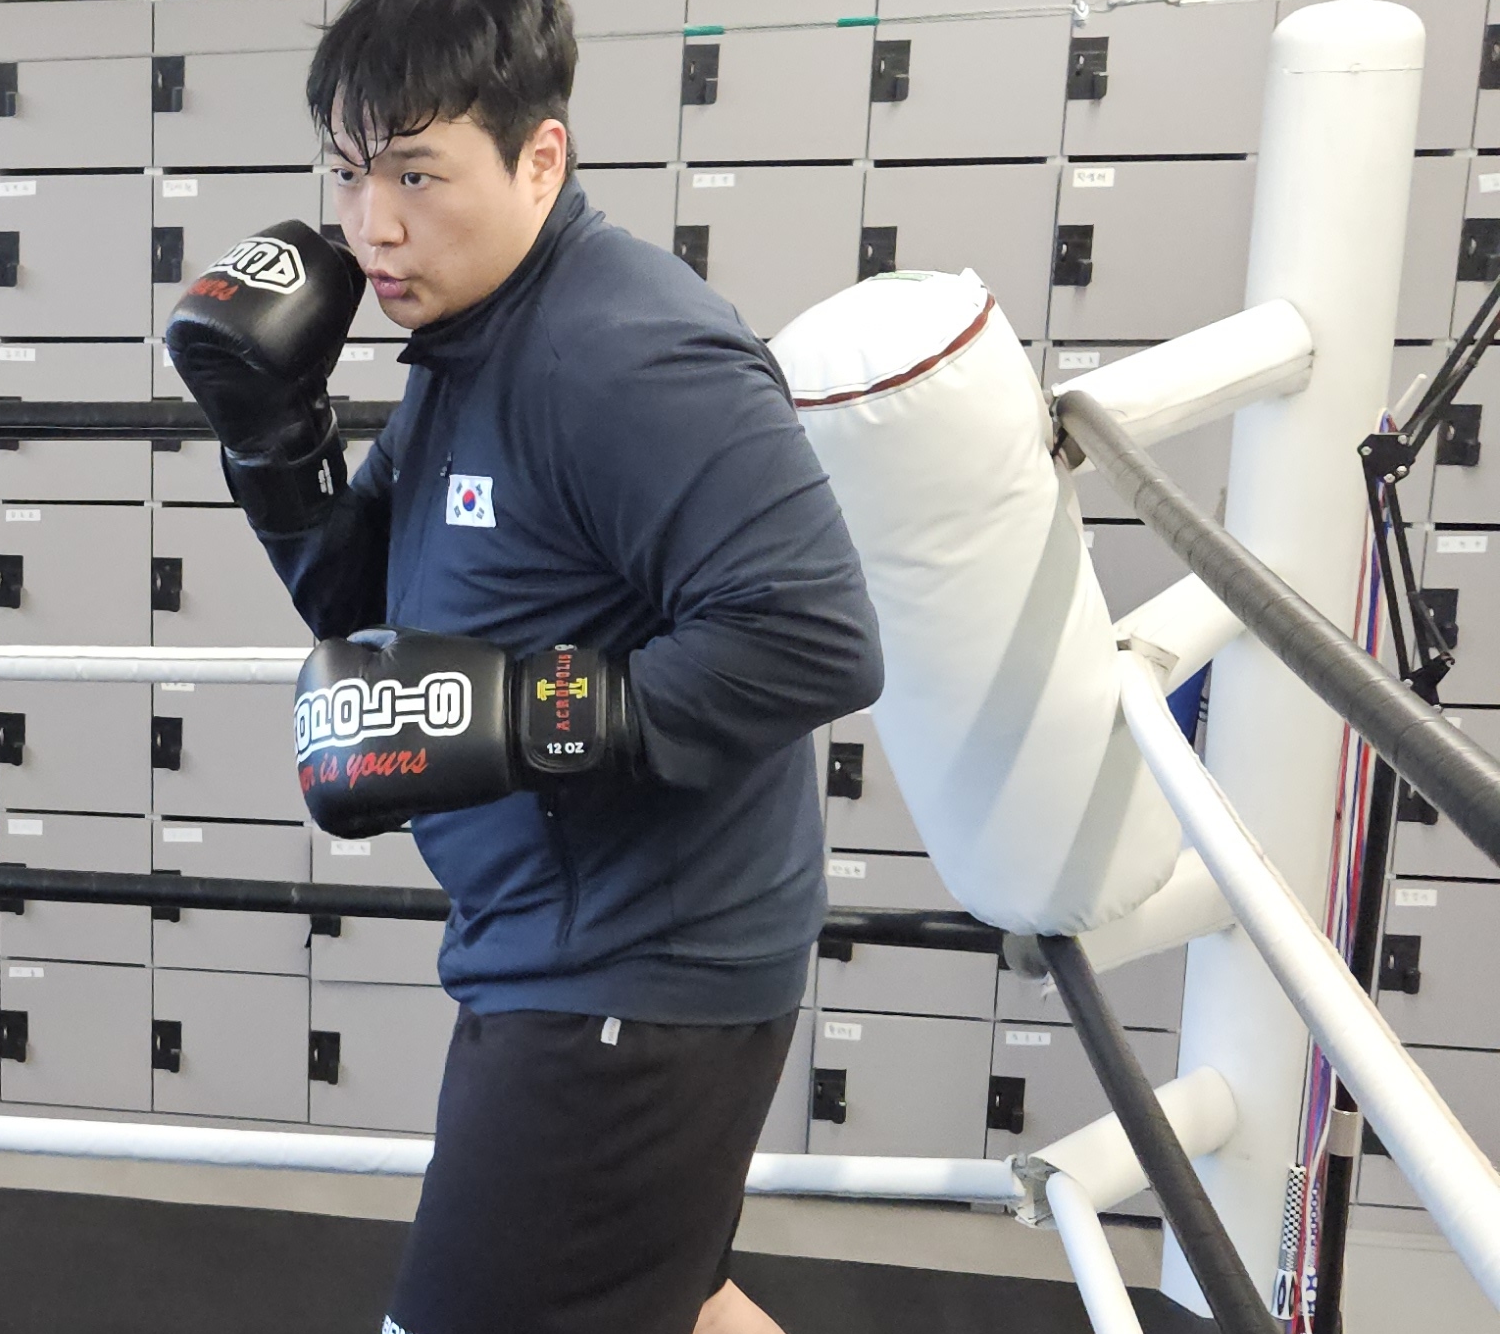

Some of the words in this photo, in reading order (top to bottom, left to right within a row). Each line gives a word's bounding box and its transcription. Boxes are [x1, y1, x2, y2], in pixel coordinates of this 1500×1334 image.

[294, 672, 472, 762] OPOLIS
[555, 653, 573, 732] ACROPOLIS
[346, 747, 429, 789] yours
[546, 742, 562, 755] 12
[564, 741, 585, 755] OZ
